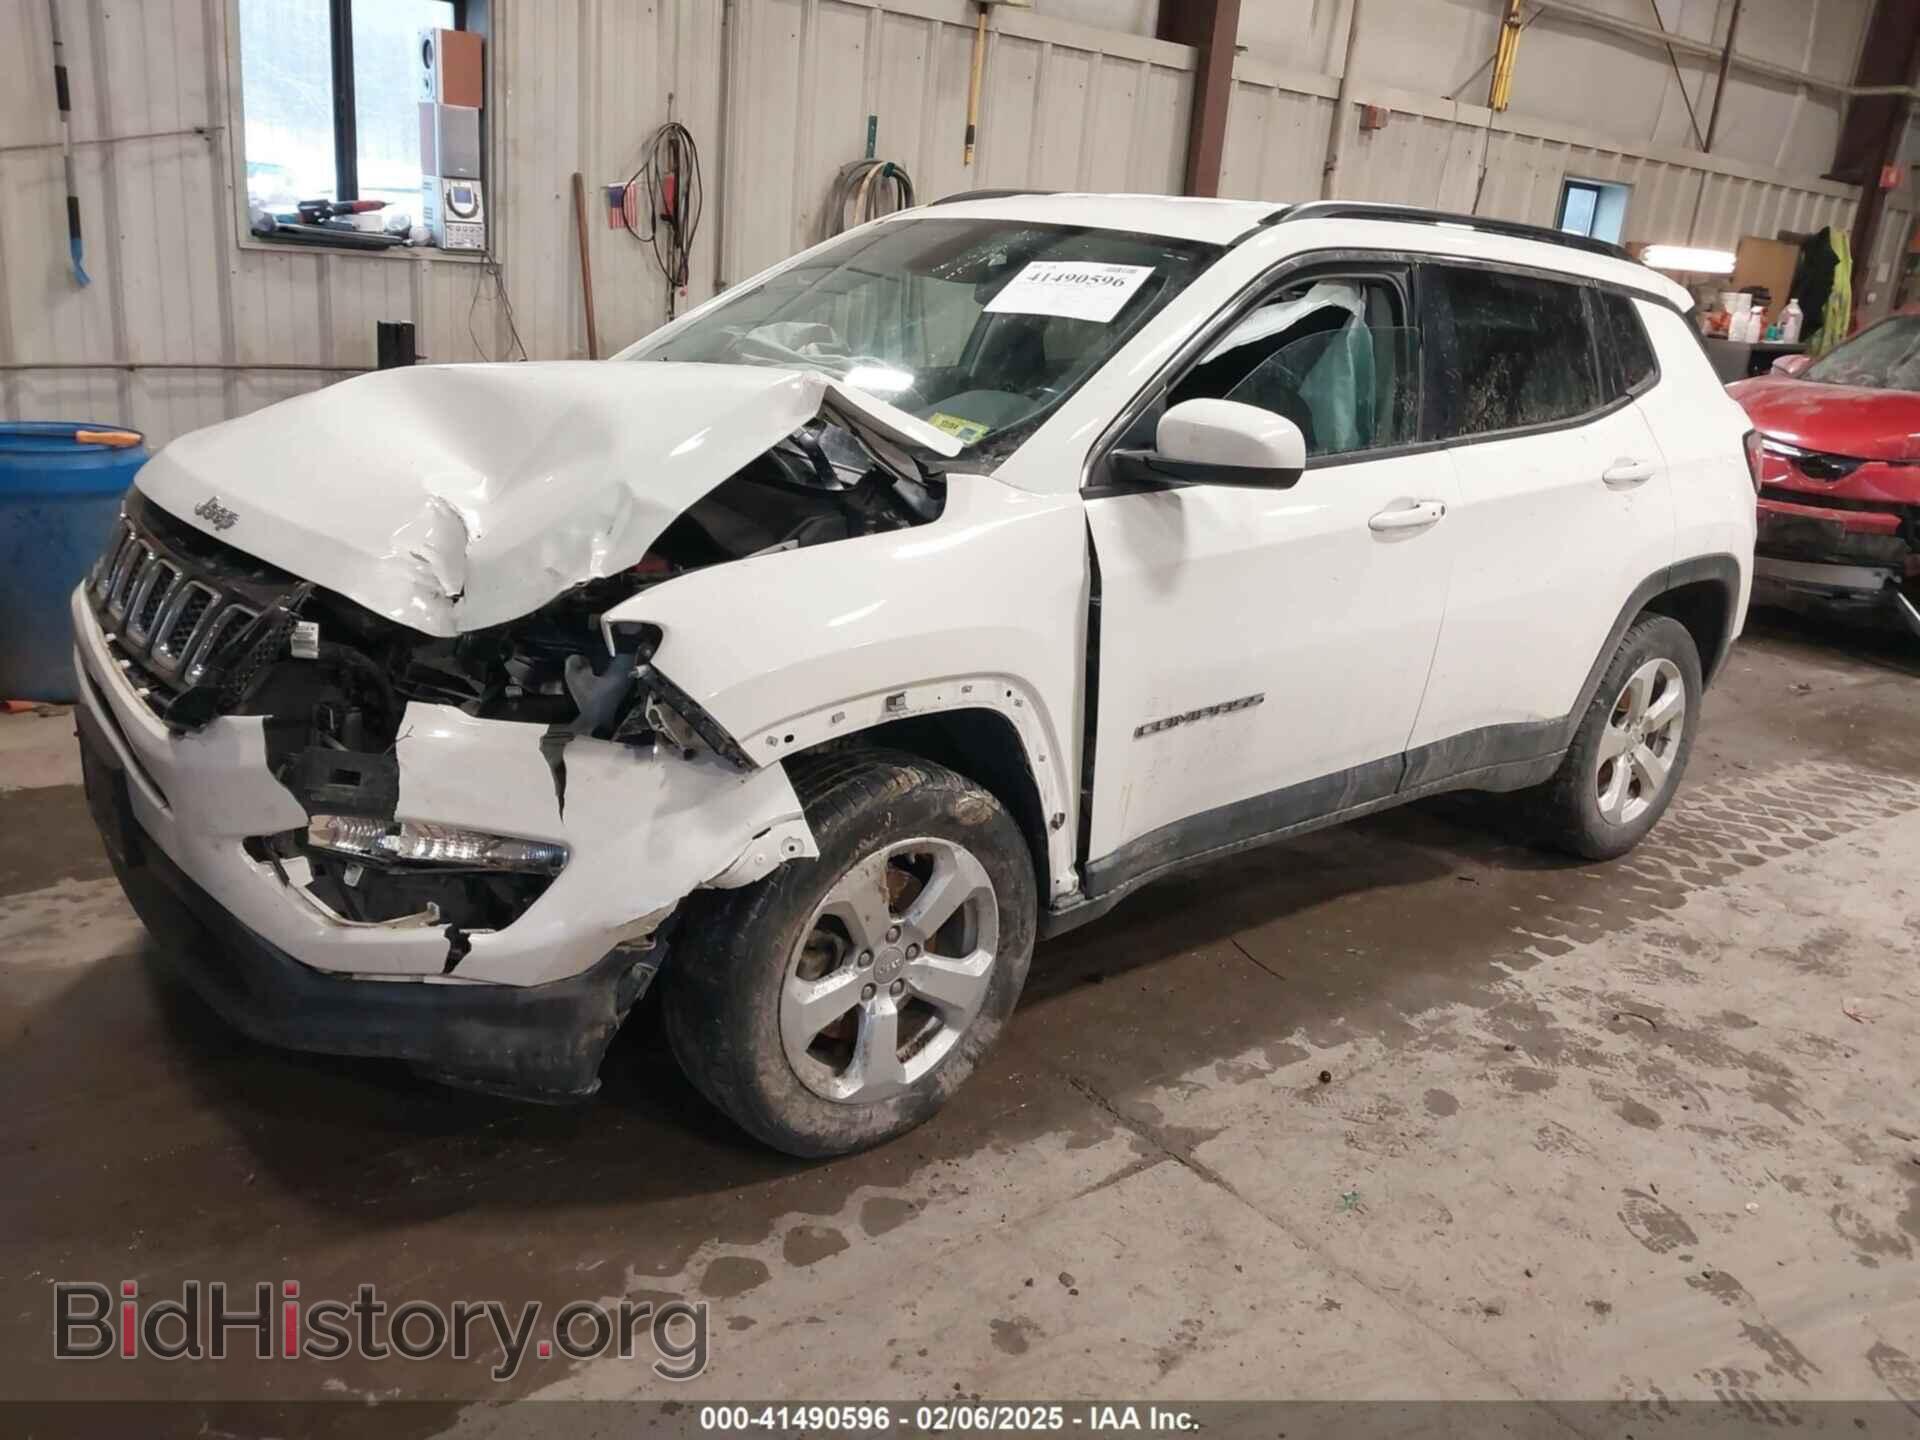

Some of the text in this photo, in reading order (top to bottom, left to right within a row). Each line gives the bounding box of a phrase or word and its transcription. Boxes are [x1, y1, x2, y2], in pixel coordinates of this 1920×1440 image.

[1026, 271, 1126, 288] 41490596
[194, 496, 239, 531] Jeep
[1132, 692, 1265, 740] COMPASS
